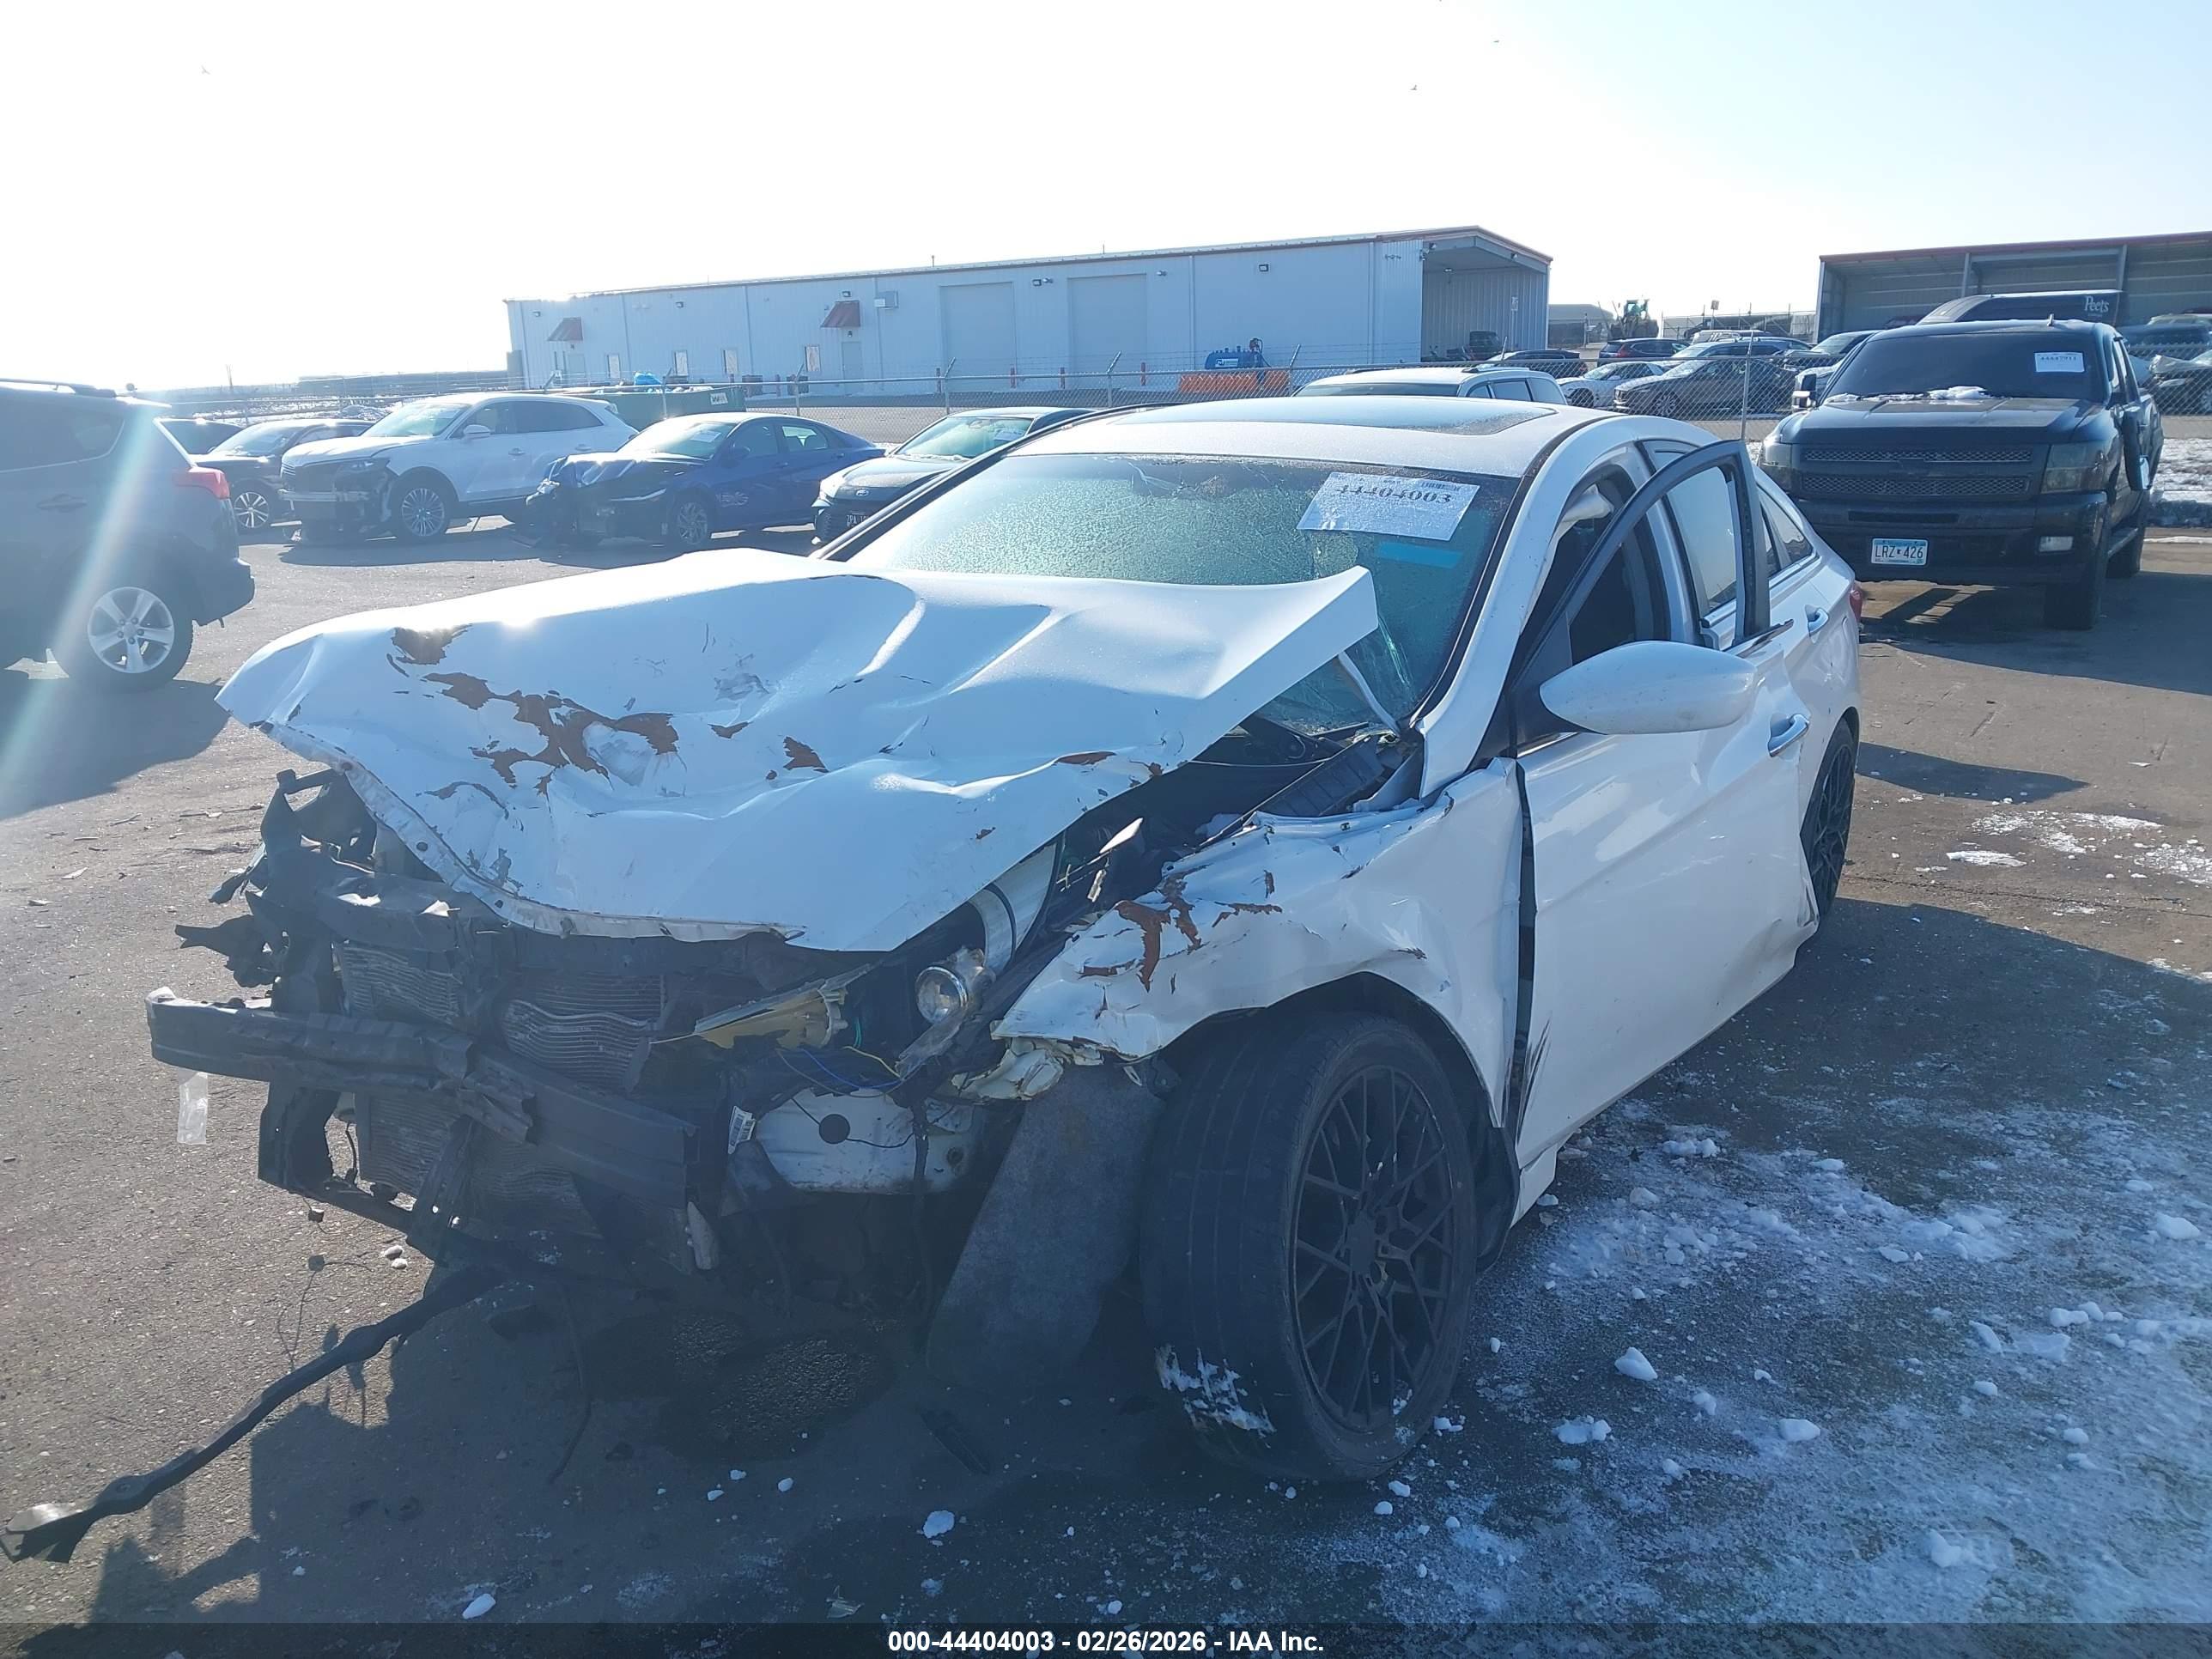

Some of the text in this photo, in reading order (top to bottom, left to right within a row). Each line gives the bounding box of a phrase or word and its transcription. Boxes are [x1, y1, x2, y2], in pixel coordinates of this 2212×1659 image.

[1336, 484, 1453, 504] 44404003
[1875, 545, 1923, 559] LRZ 426
